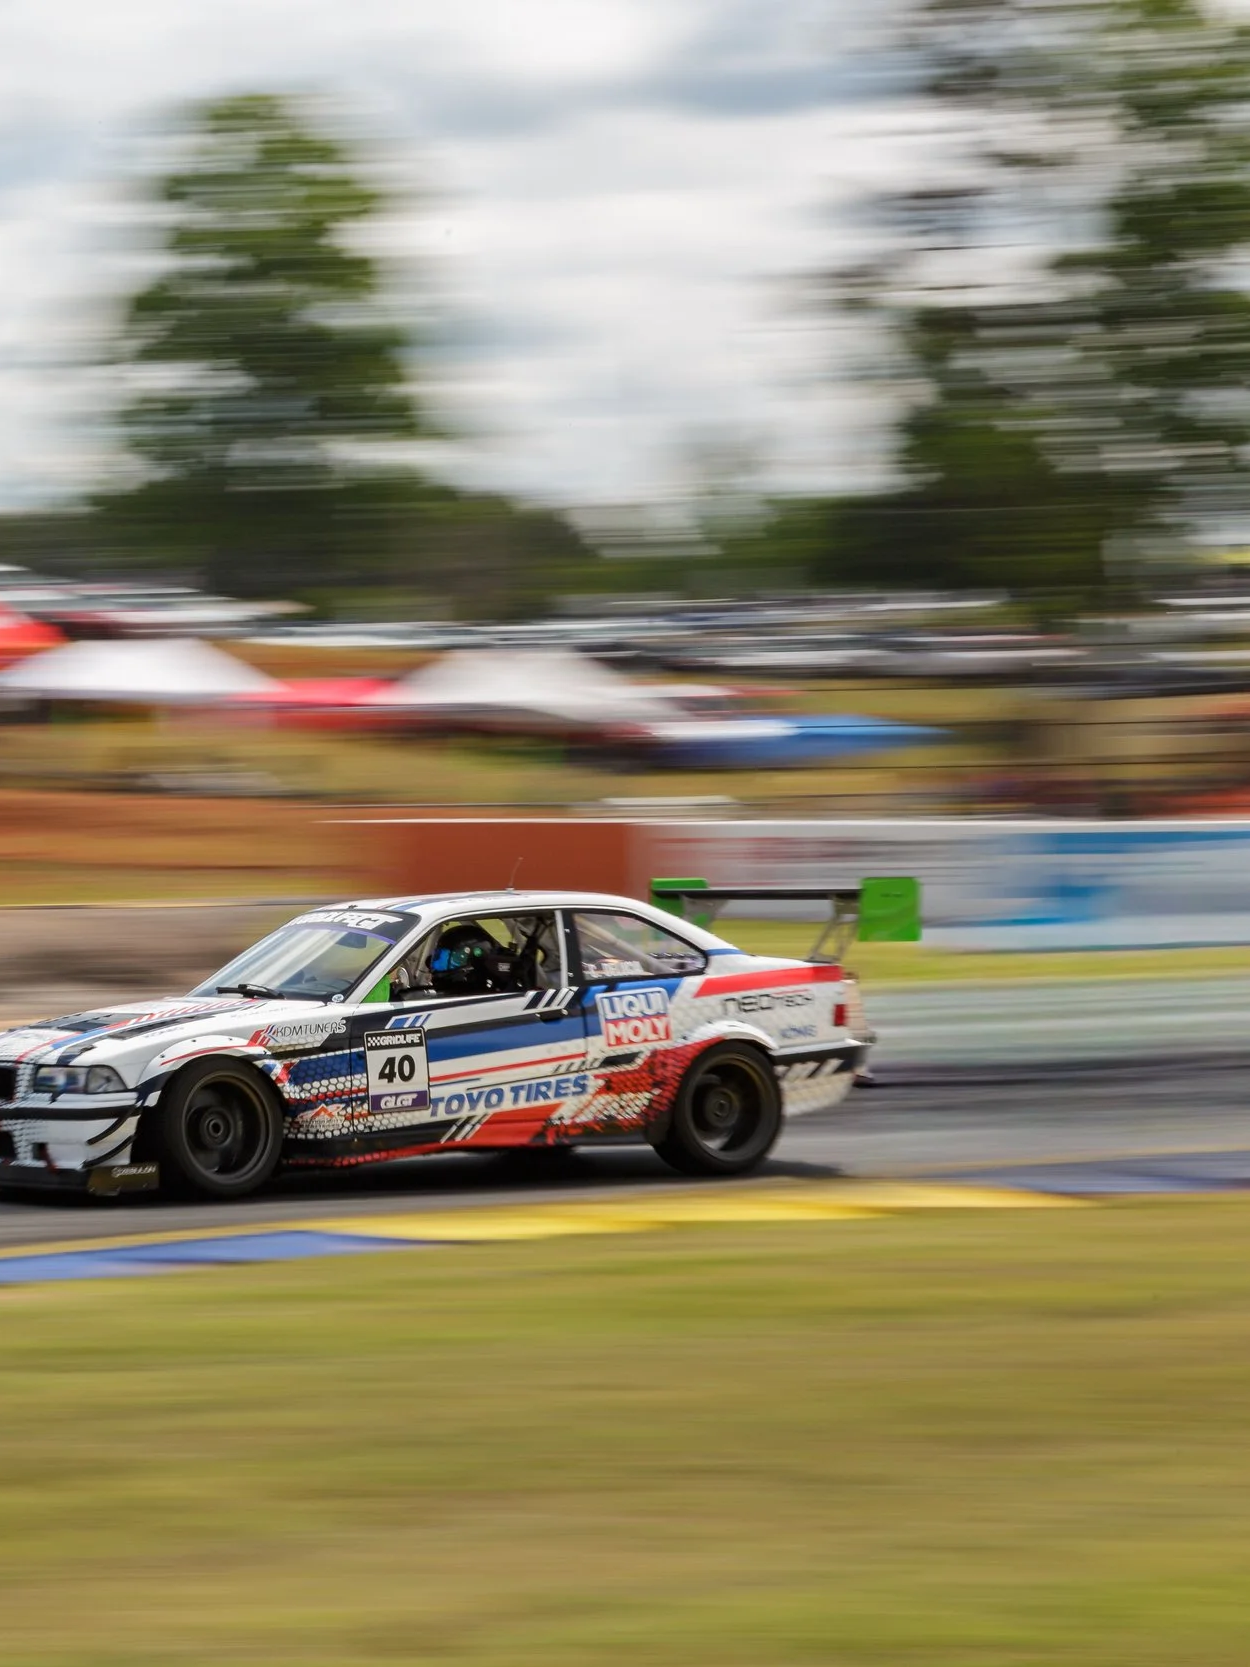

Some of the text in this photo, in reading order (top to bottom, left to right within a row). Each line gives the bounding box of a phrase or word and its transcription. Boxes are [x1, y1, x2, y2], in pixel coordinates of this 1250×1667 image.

[603, 992, 663, 1019] LIQUI
[380, 1033, 422, 1046] GRIDLIFE
[606, 1017, 669, 1045] MOLY
[378, 1054, 416, 1083] 40
[429, 1074, 589, 1117] TOYO TIRES
